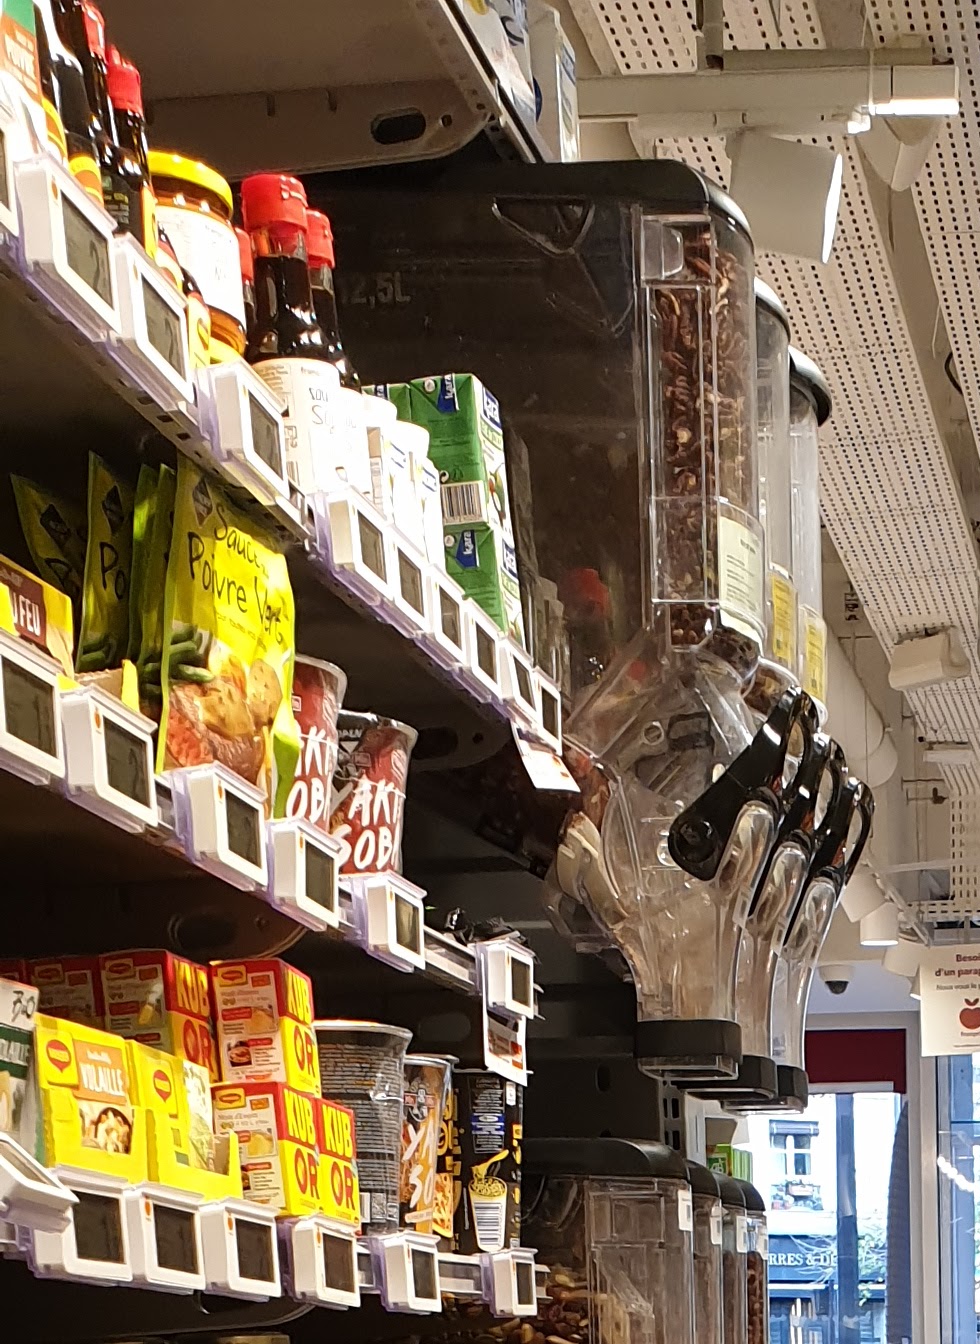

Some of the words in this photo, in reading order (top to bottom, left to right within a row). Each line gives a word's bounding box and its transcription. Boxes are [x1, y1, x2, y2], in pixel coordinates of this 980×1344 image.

[188, 531, 248, 614] Poivre
[174, 959, 210, 1017] KUB
[287, 968, 311, 1025] KUB
[935, 968, 955, 977] d'un
[183, 1020, 216, 1079] OR
[294, 1025, 316, 1078] OR
[80, 1063, 126, 1097] VOLAILLE
[283, 1089, 316, 1144] KUB
[322, 1103, 354, 1158] KUB
[294, 1147, 320, 1200] OR
[330, 1161, 356, 1210] OR
[806, 1254, 817, 1266] &
